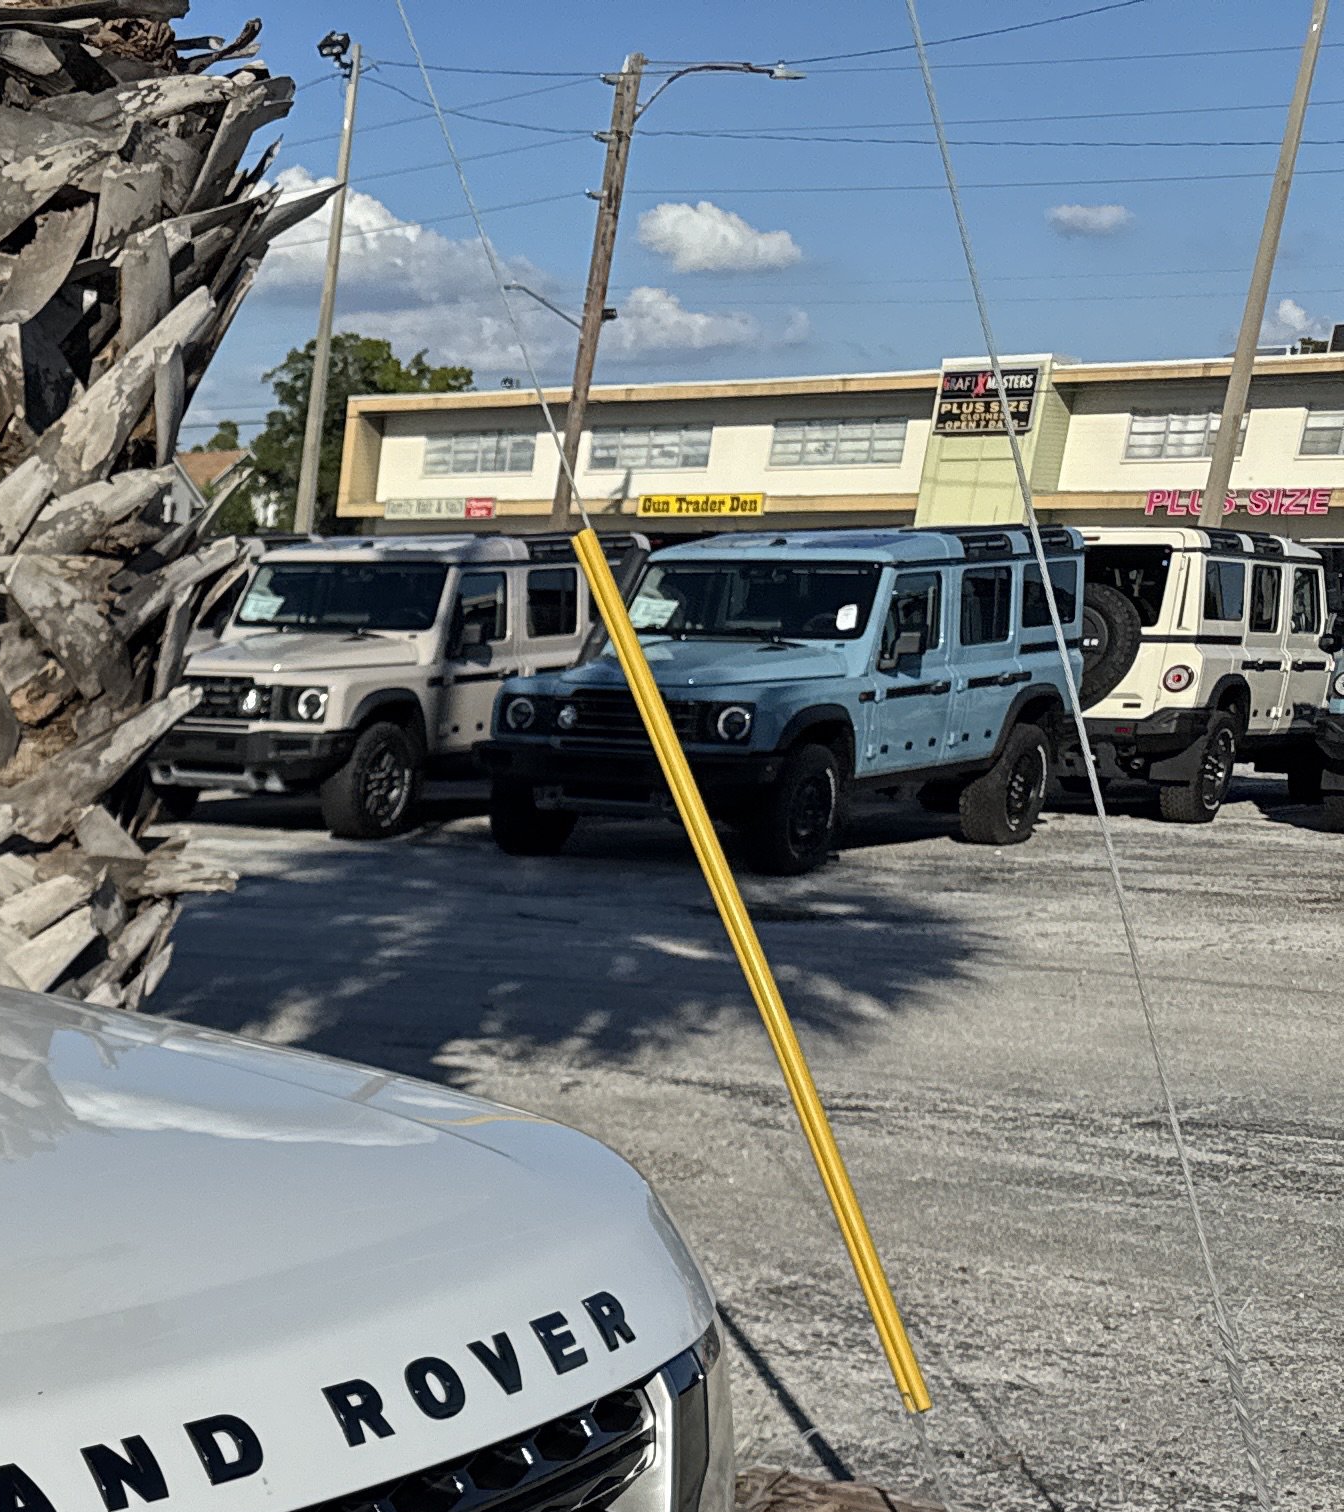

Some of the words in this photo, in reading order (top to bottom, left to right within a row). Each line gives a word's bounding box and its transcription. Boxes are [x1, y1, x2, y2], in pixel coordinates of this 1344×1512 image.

[940, 401, 985, 414] PLUS
[990, 400, 1030, 413] SZE
[945, 420, 977, 431] OPEN
[642, 497, 670, 513] Gun
[675, 496, 725, 513] Trader
[729, 496, 758, 512] Den
[1144, 489, 1238, 515] PLUS
[1247, 487, 1332, 516] SIZE
[321, 1290, 636, 1447] ROVER
